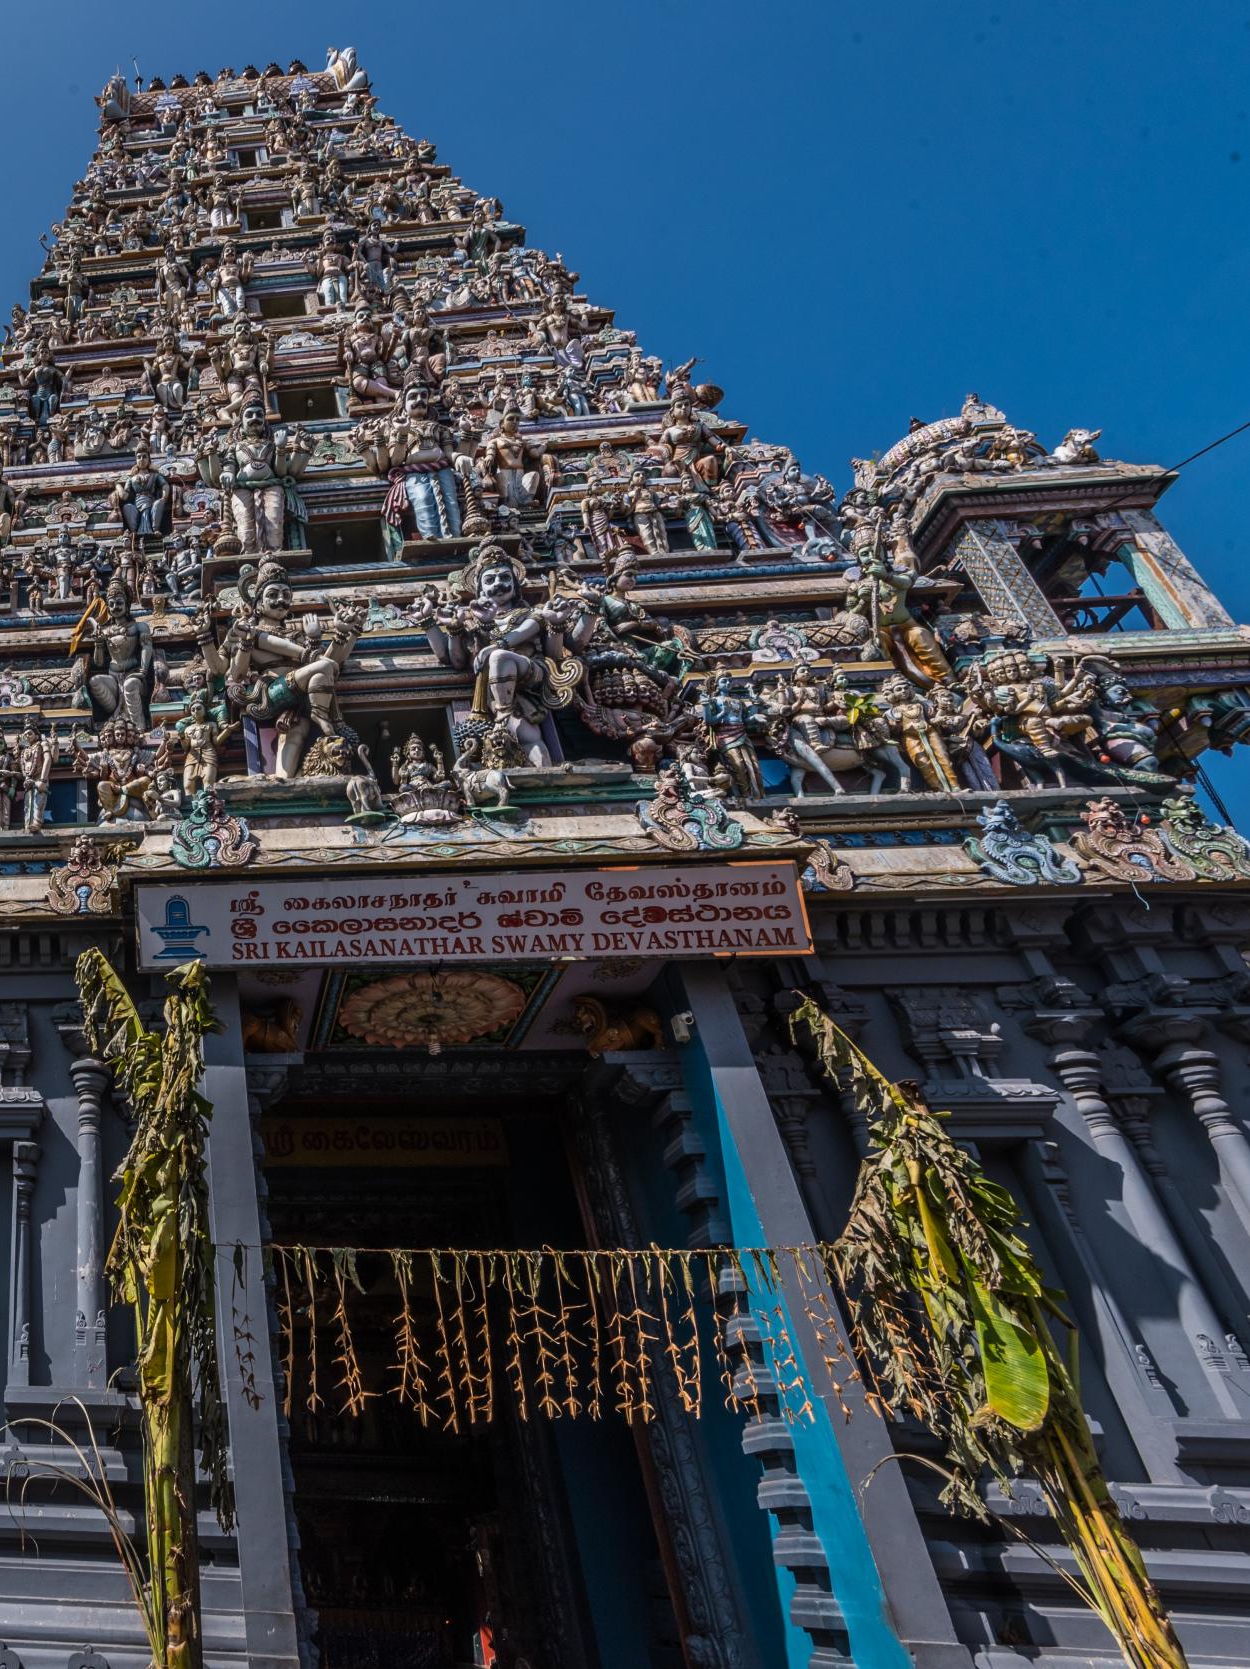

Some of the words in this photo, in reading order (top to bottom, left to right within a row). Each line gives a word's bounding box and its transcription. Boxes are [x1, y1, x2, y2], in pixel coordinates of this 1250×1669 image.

[283, 886, 457, 912] கைலாசநாதர்
[476, 881, 566, 905] சுவாமி
[584, 874, 787, 905] தேவஸ்தானம்
[232, 942, 271, 960] SRI
[275, 936, 485, 959] KAILASANATHAR
[491, 931, 584, 955] SWAMY
[591, 926, 798, 952] DEVASTHANAM
